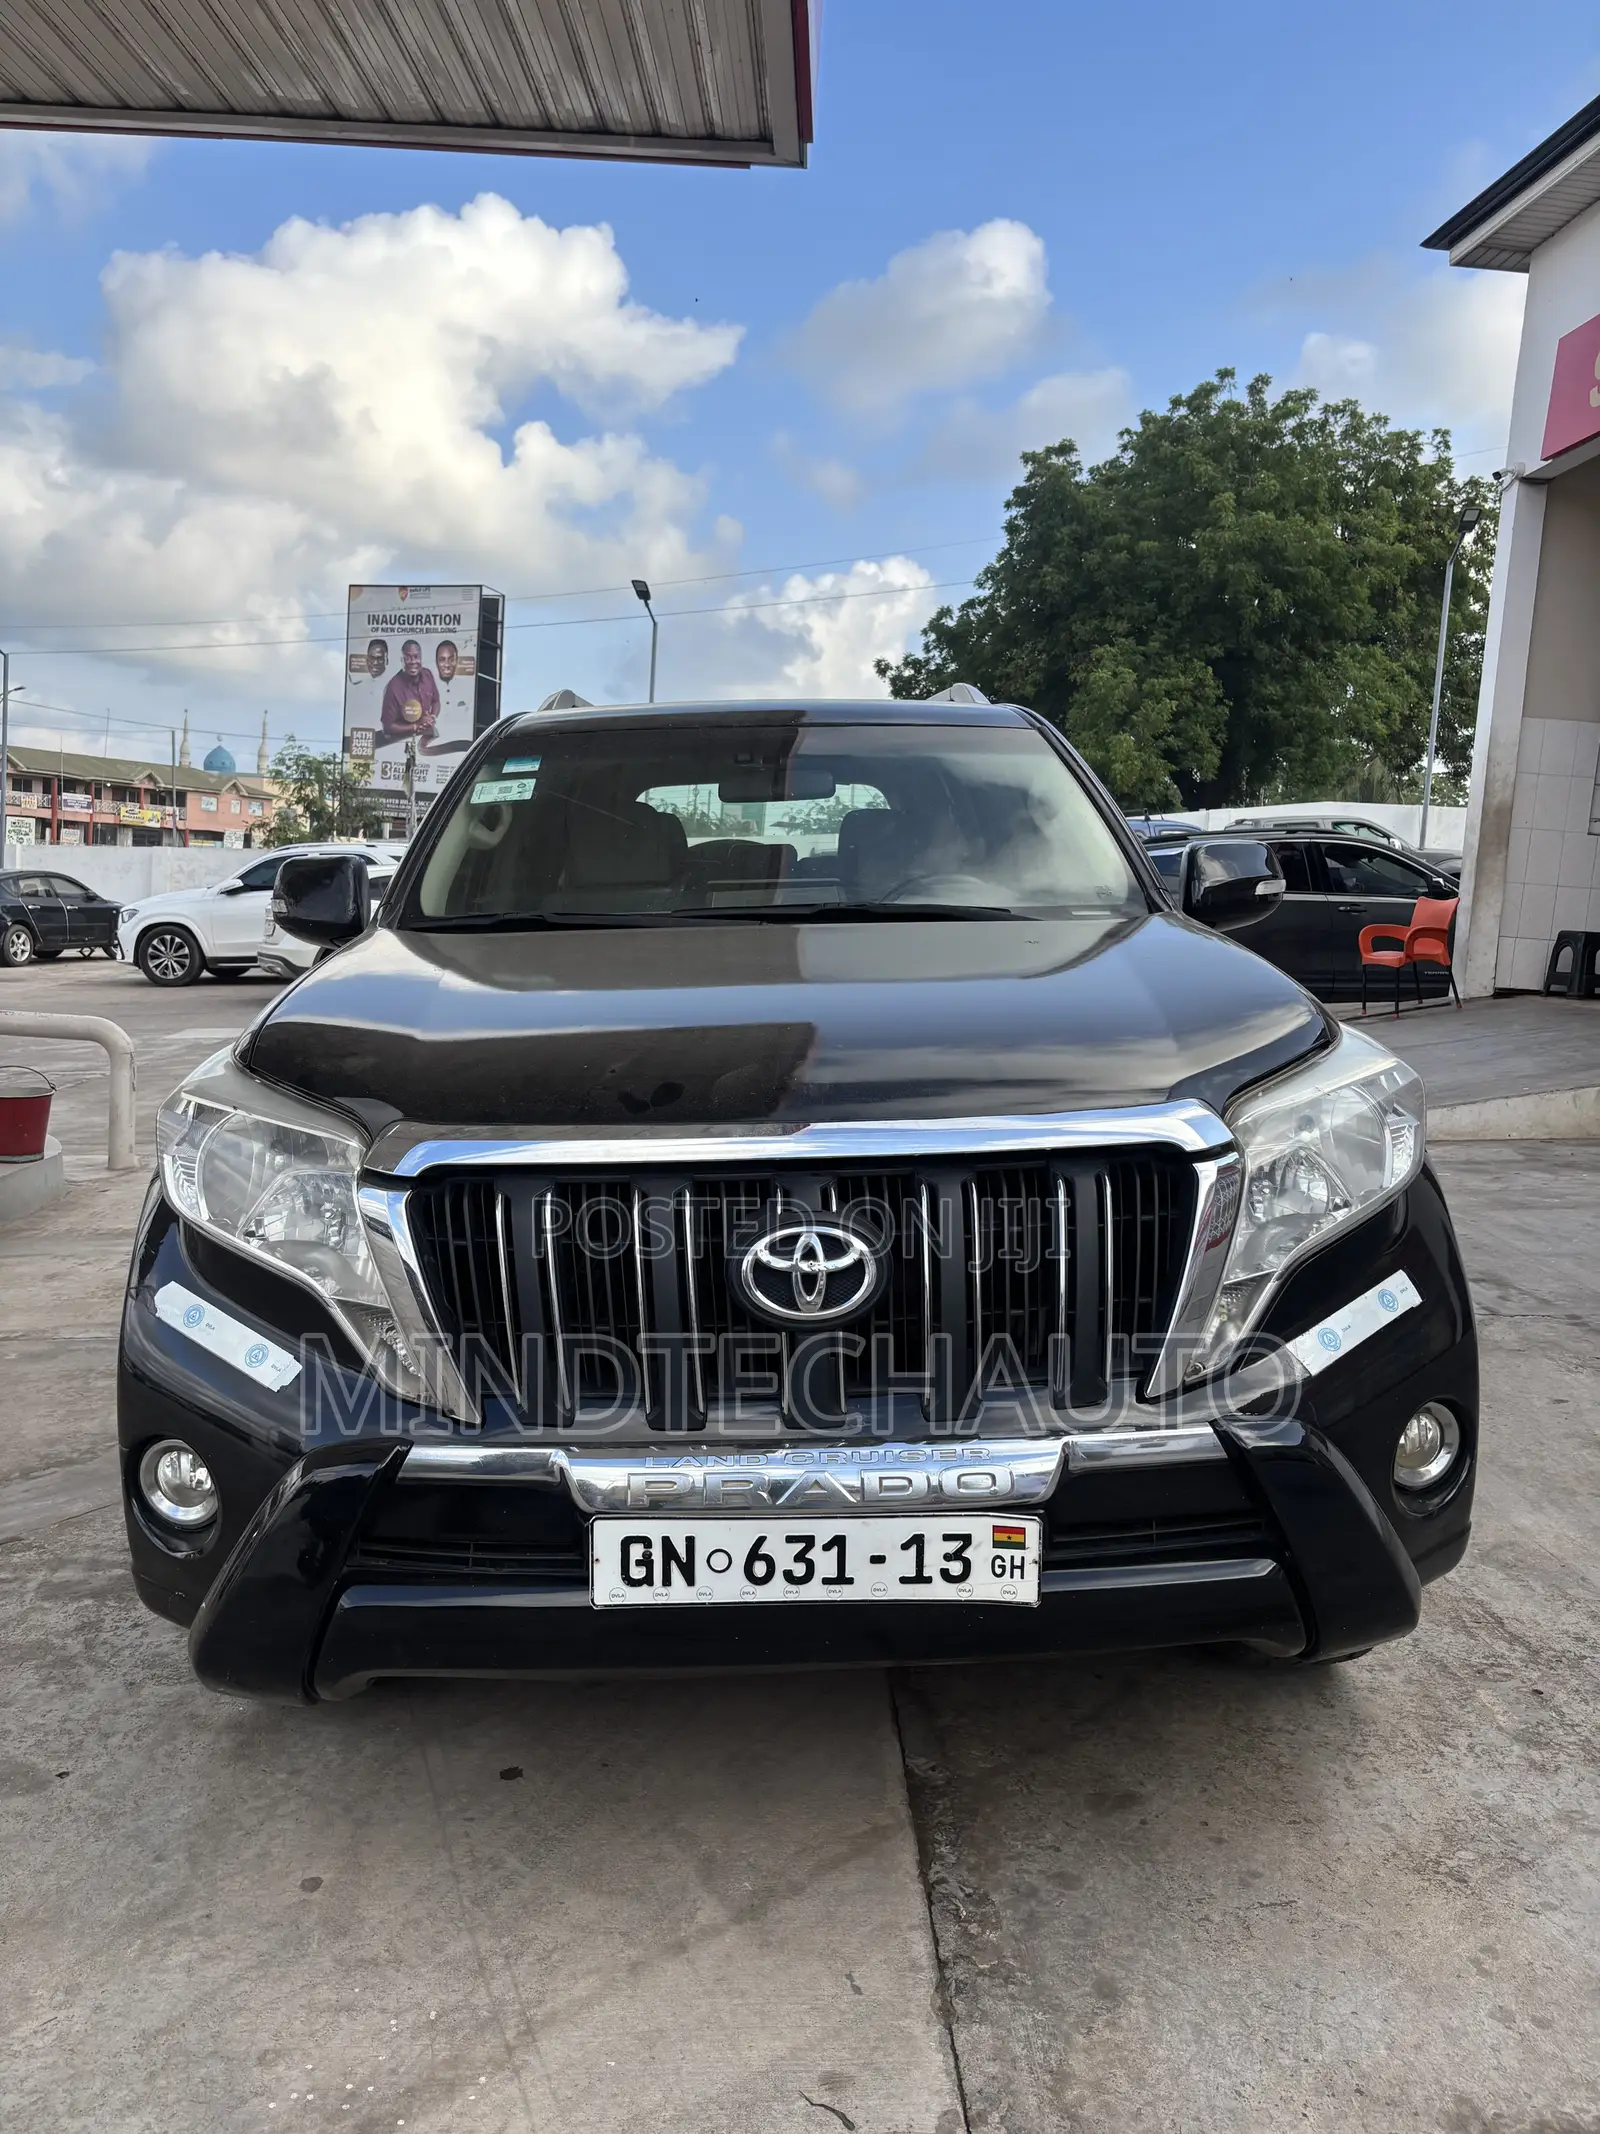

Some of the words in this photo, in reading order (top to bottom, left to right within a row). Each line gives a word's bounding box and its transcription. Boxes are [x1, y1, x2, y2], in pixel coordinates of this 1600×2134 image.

[367, 613, 461, 626] INAUGURATION
[352, 731, 373, 739] 14TH
[352, 740, 373, 748] JUNE
[382, 763, 391, 779] 3
[643, 1454, 769, 1469] LAND
[784, 1448, 993, 1466] CRUISER
[626, 1465, 1015, 1507] PRADO
[620, 1535, 696, 1587] GN
[990, 1554, 1026, 1580] GH
